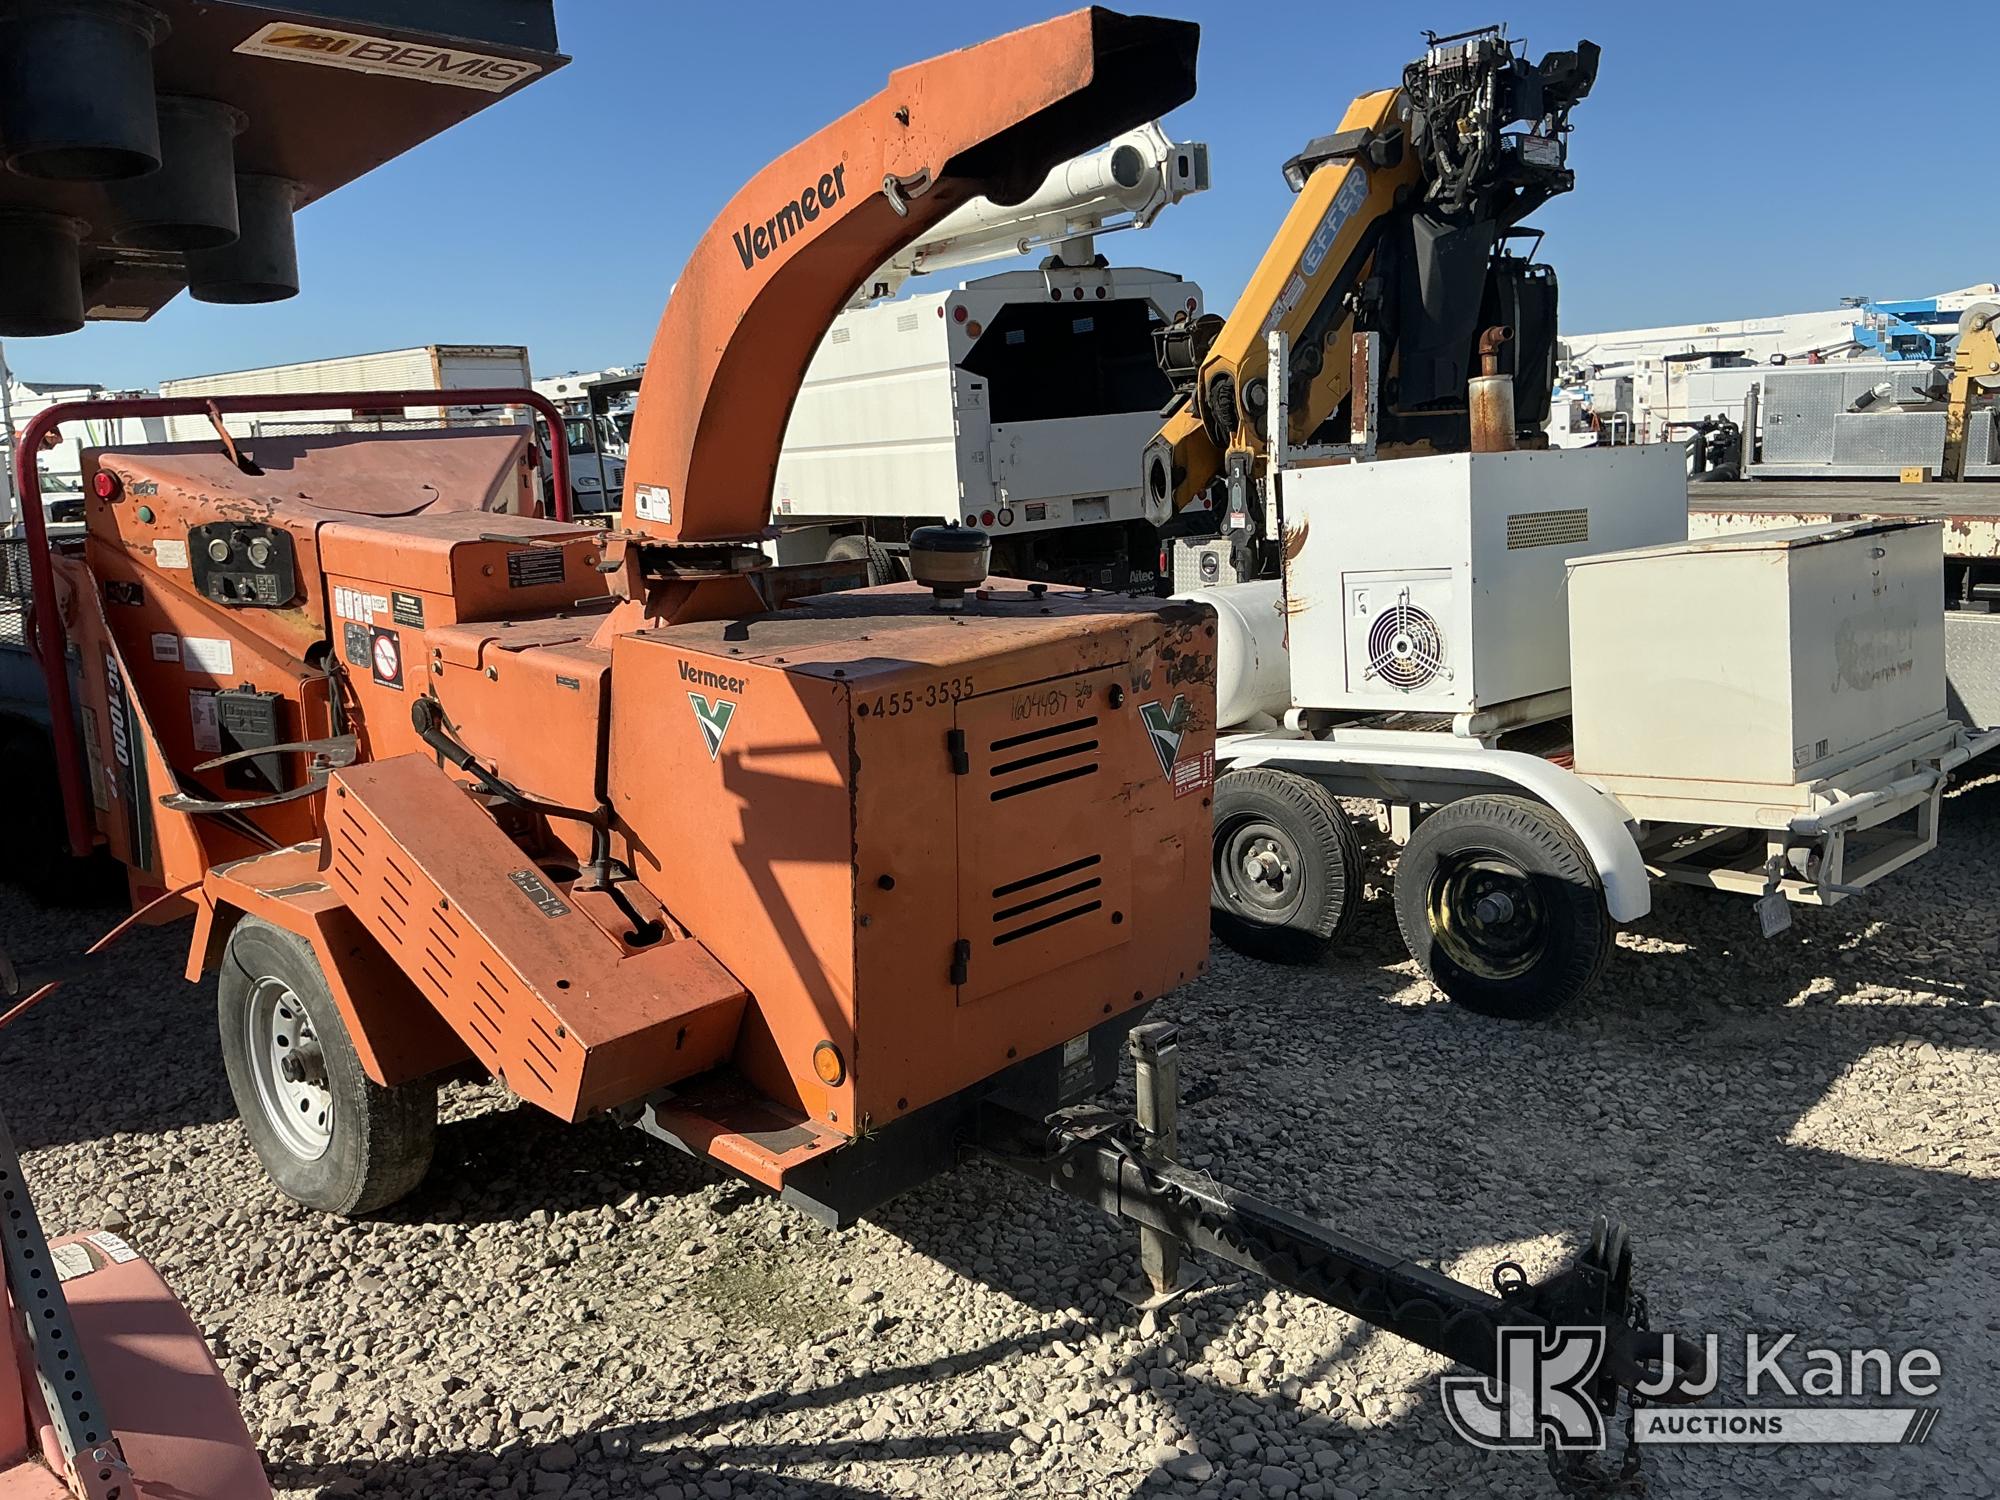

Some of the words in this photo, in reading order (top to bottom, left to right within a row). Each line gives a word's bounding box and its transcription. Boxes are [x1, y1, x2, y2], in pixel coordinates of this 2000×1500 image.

[348, 41, 528, 81] BEMIS
[732, 161, 846, 271] Vermeer
[1307, 170, 1364, 268] EFFER
[1234, 467, 1240, 478] 3
[677, 659, 745, 695] Vermeer
[872, 676, 974, 719] 455-3535
